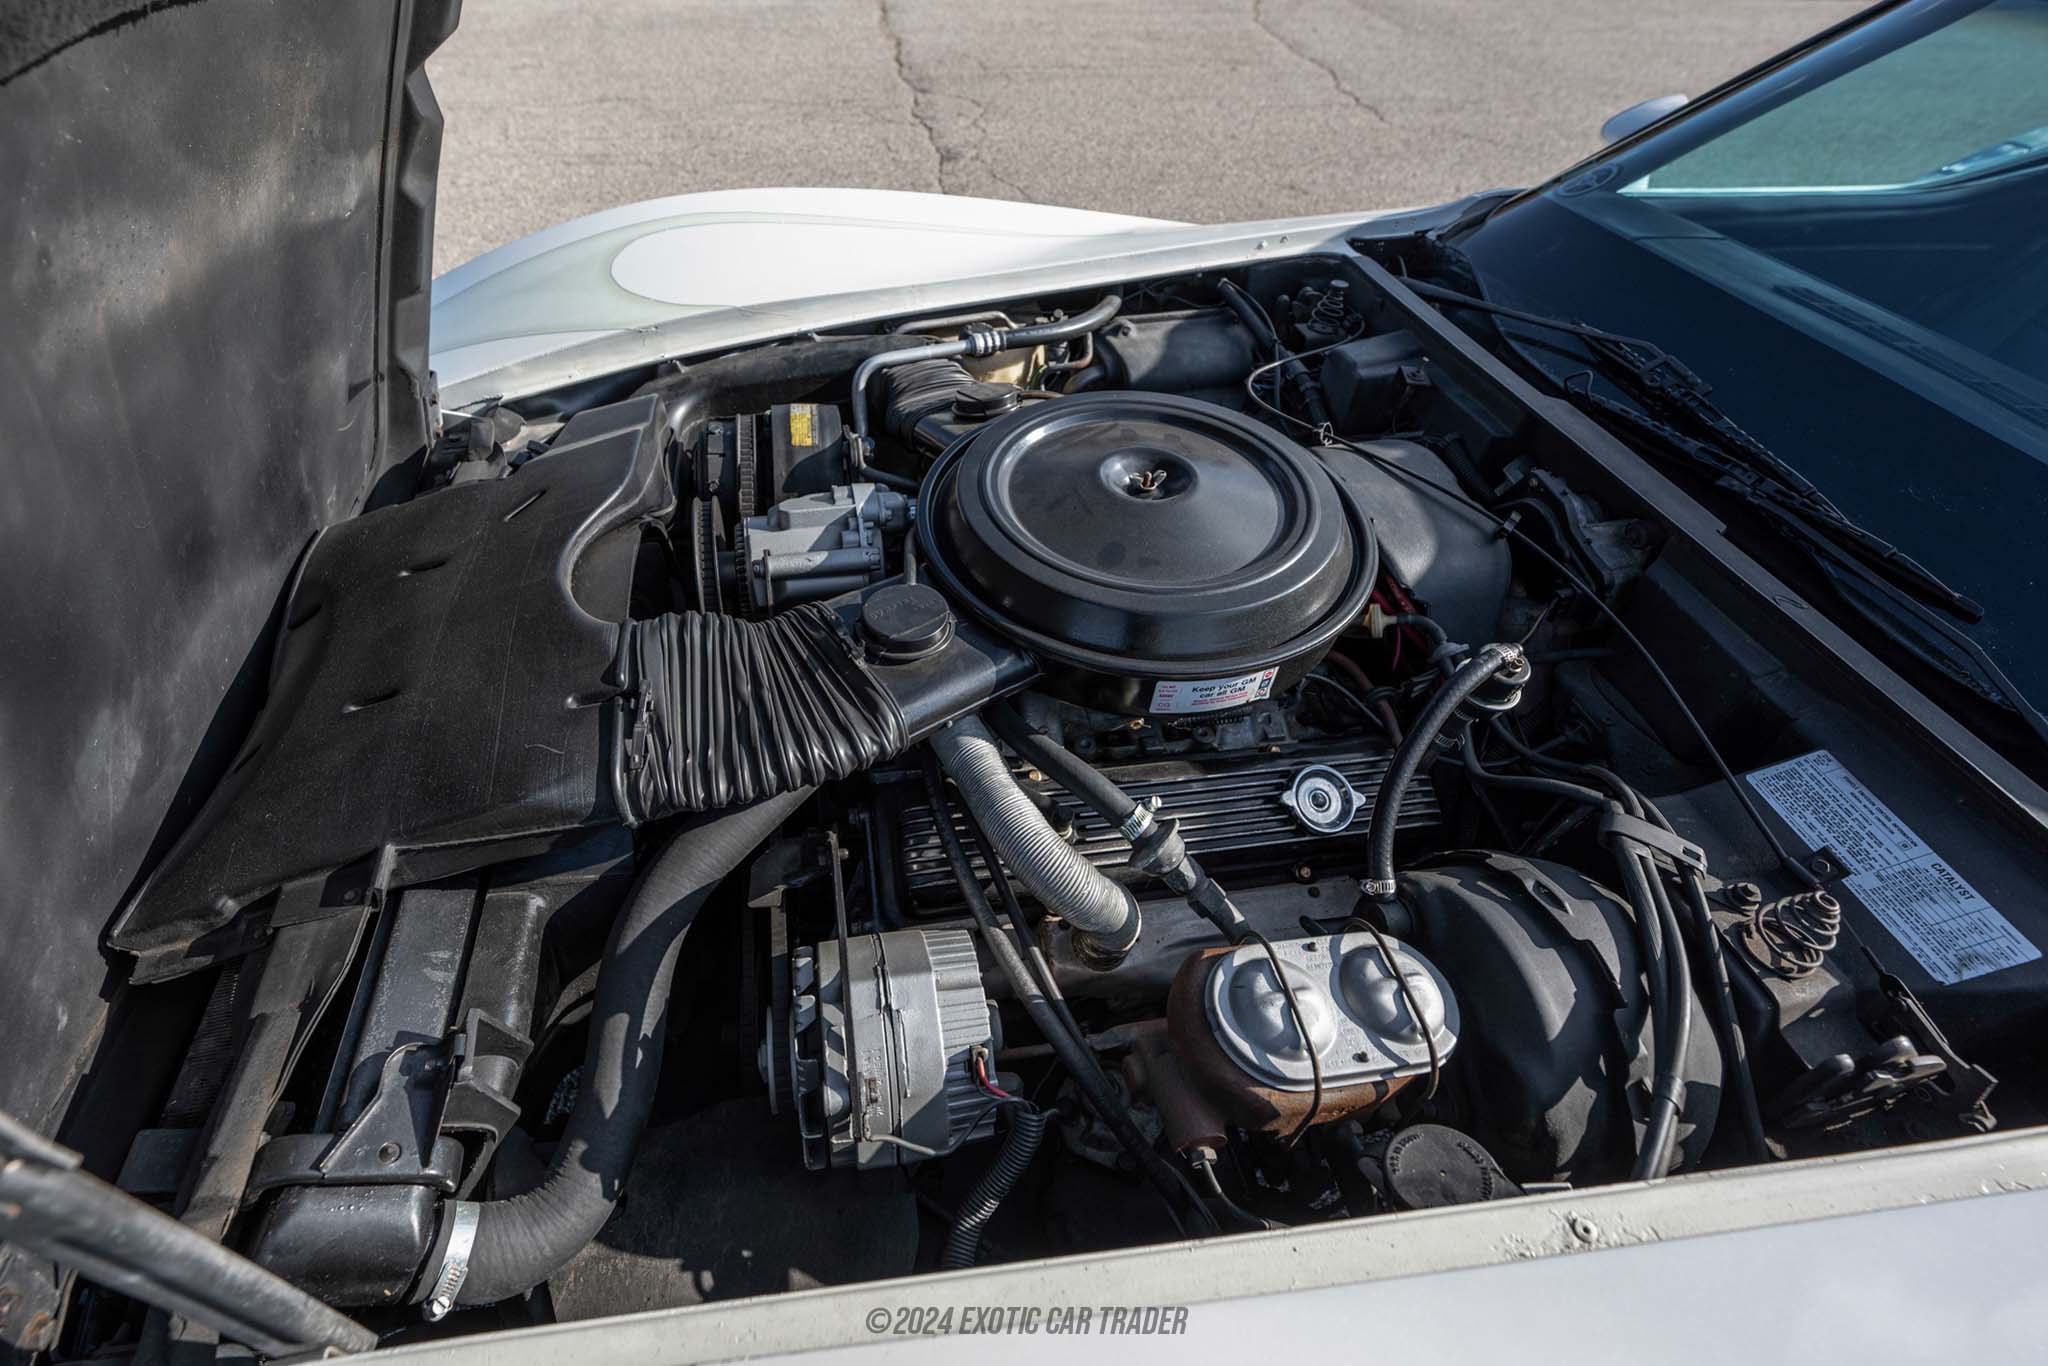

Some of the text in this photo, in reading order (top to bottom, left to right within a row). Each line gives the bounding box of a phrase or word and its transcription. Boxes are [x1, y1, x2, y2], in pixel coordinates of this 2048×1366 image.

[1192, 685, 1216, 693] Keep
[1218, 683, 1239, 691] your
[1241, 677, 1257, 685] GM
[1230, 686, 1246, 694] GM
[1931, 863, 1976, 900] CATALYST
